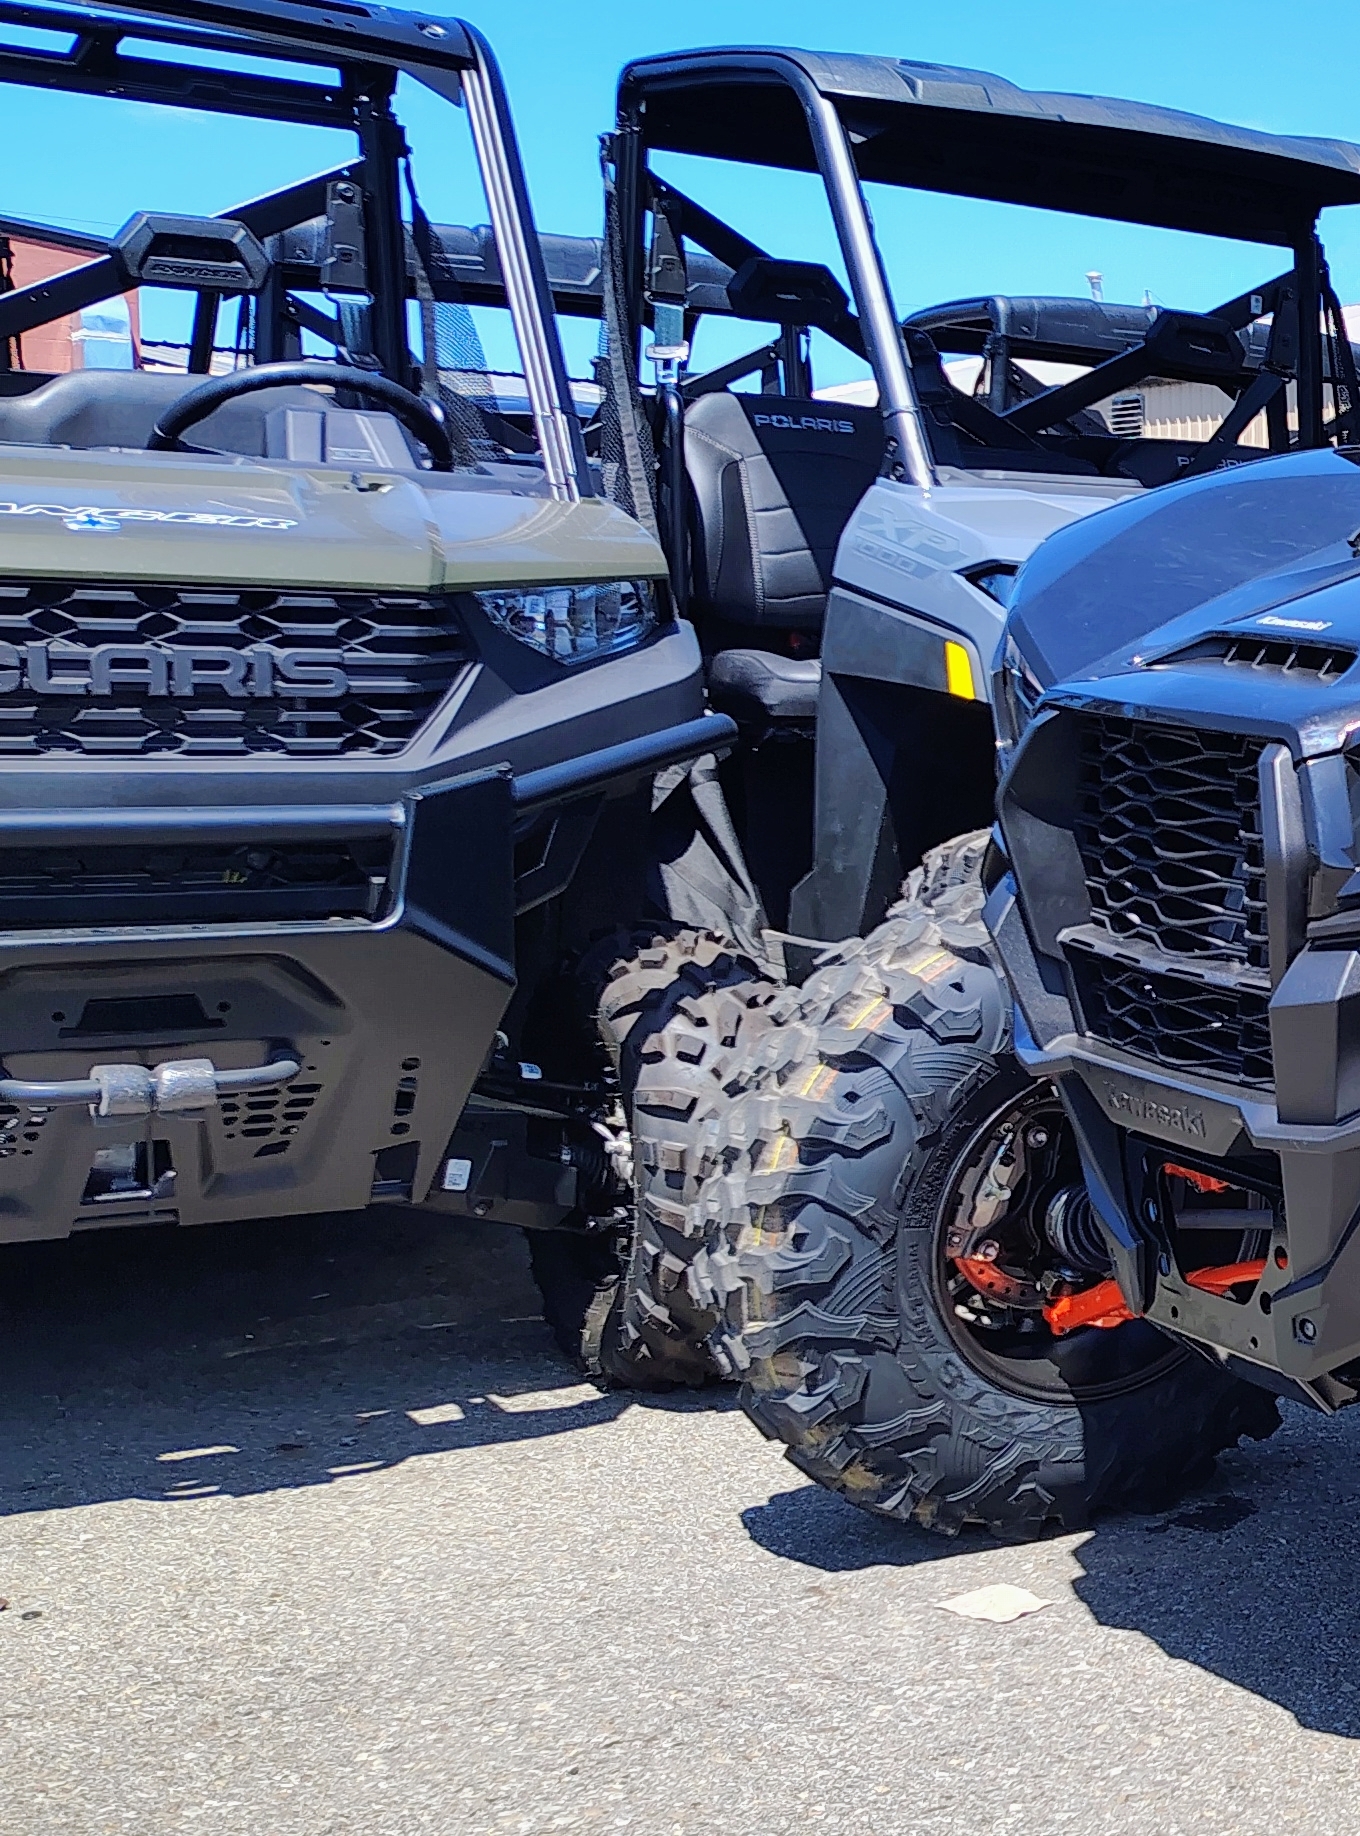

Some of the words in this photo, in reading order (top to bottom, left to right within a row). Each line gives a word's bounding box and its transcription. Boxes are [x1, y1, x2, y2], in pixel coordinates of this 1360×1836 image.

[754, 414, 855, 434] POLARIS
[1256, 615, 1333, 631] Kawasaki
[0, 643, 350, 698] LARIS
[1102, 1079, 1207, 1138] Kawasaki
